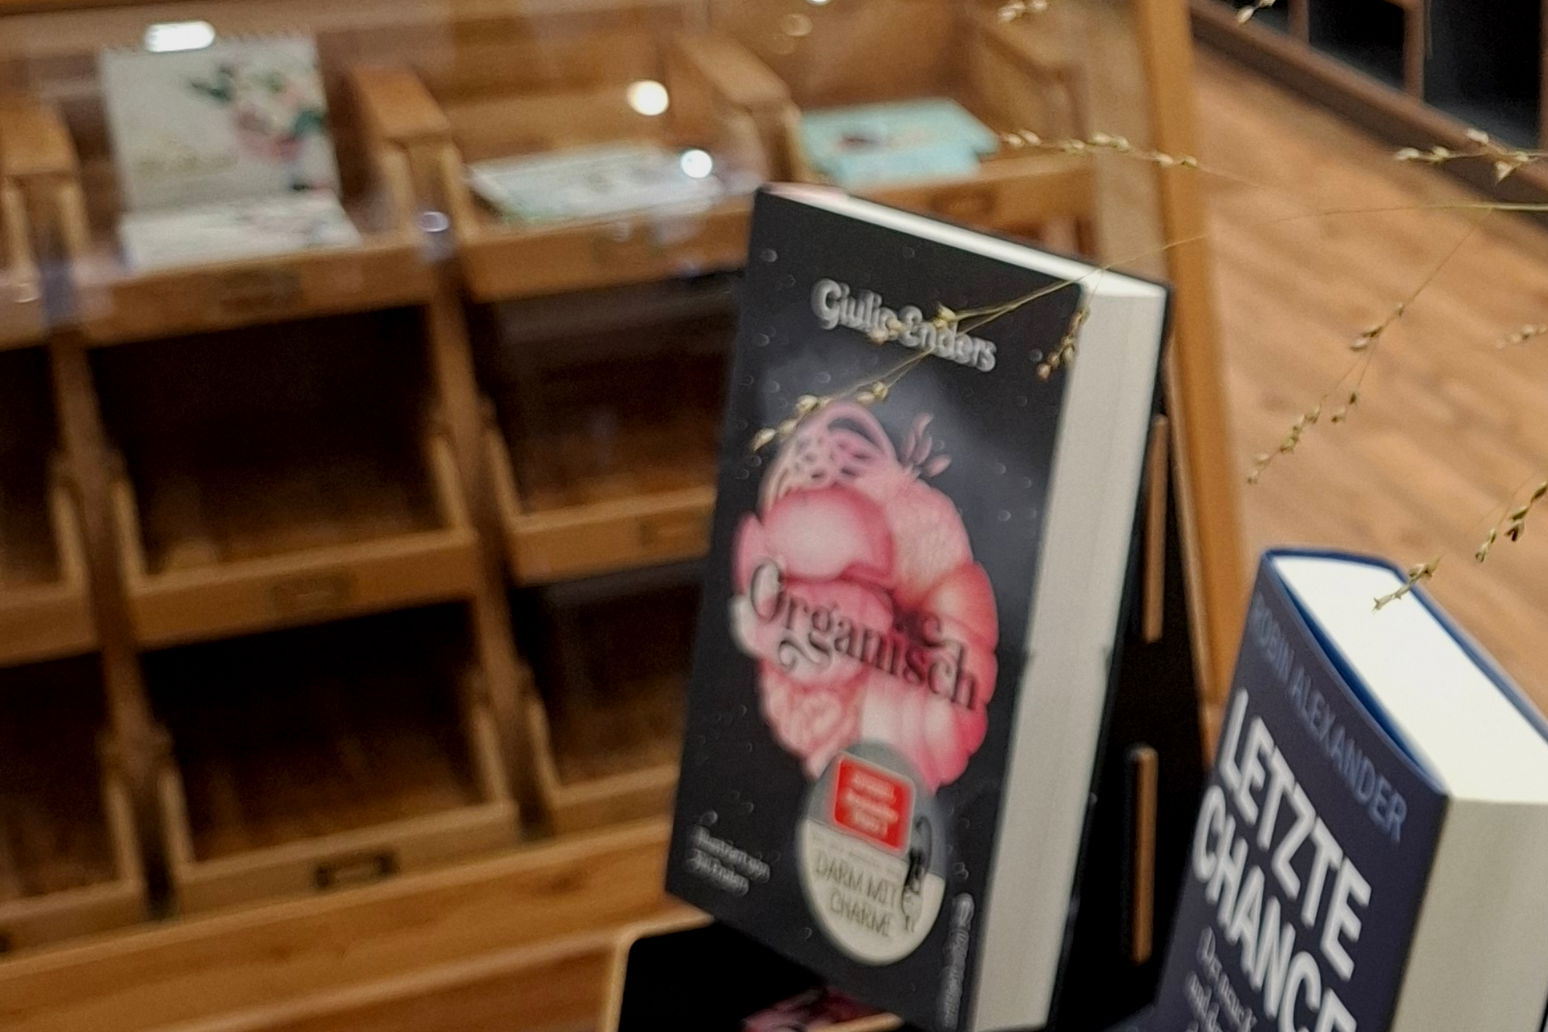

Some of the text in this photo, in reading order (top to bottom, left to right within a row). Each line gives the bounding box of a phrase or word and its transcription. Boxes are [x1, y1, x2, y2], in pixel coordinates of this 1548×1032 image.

[899, 305, 997, 372] Enders
[751, 562, 977, 710] Organisch
[1288, 666, 1408, 843] ALEXANDER
[816, 850, 863, 894] DARM
[1218, 687, 1372, 982] LETZTE
